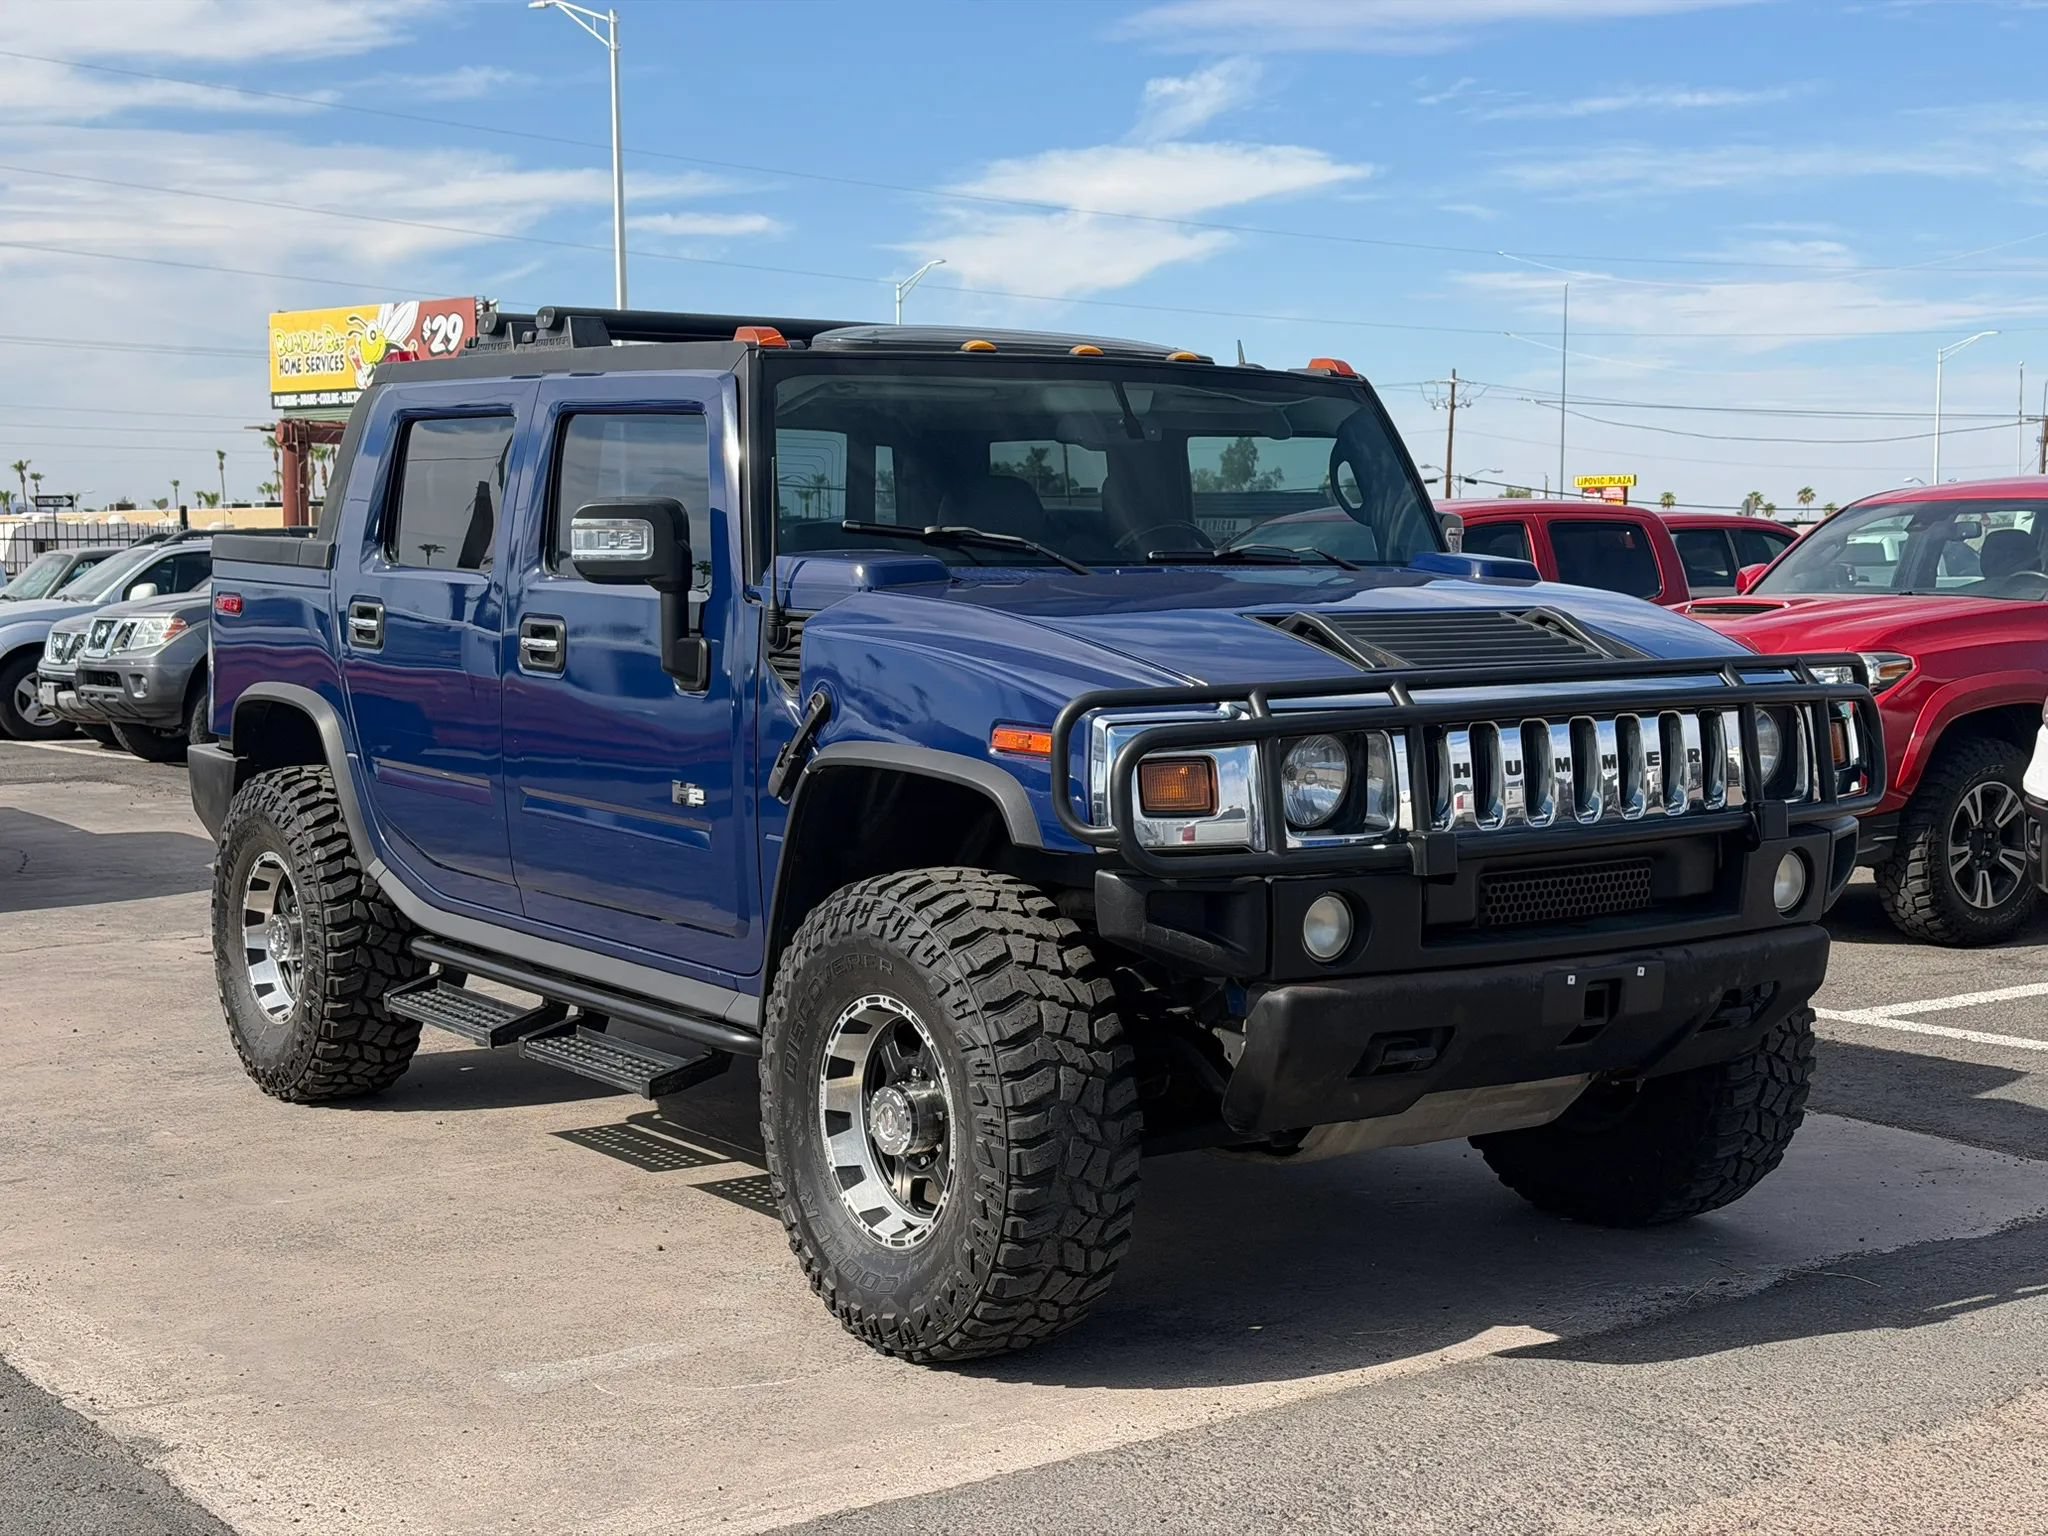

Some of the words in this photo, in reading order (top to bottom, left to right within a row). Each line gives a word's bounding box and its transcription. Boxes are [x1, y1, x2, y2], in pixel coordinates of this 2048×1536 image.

[422, 312, 464, 354] $29
[280, 357, 302, 376] HOME
[306, 354, 345, 373] SERVICES
[1577, 476, 1605, 486] LIPOVIC
[1608, 475, 1632, 484] PLAZA
[1452, 747, 1700, 778] HUMMER
[672, 779, 705, 807] H2
